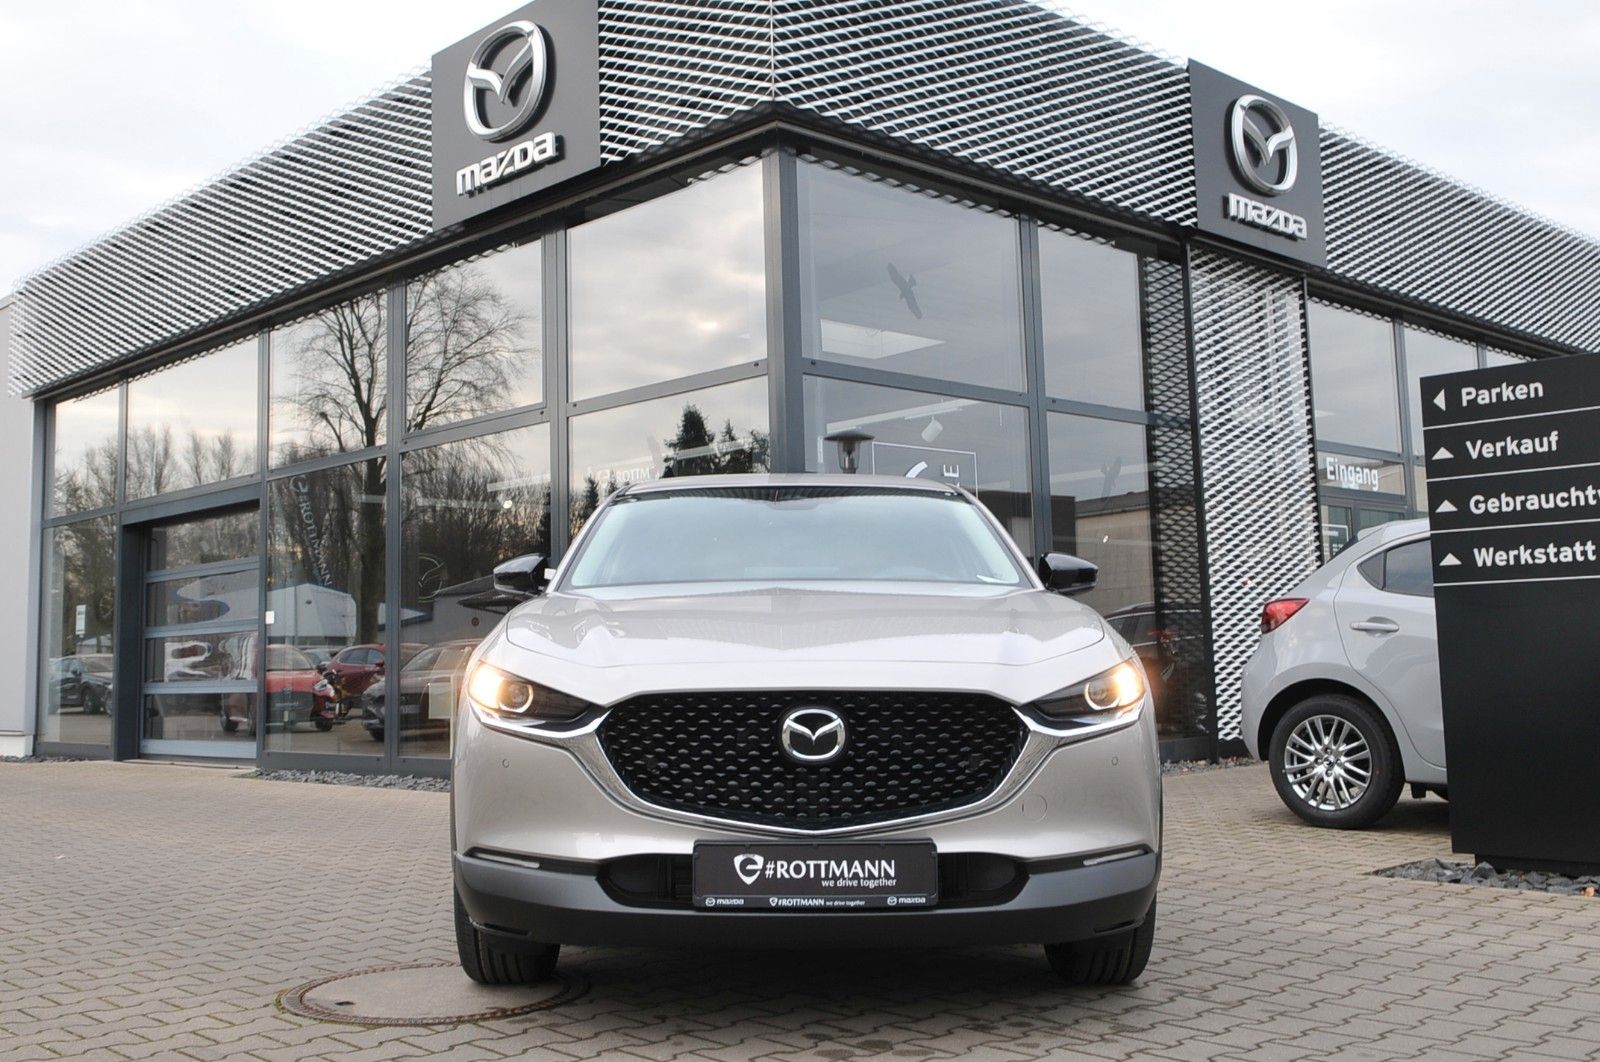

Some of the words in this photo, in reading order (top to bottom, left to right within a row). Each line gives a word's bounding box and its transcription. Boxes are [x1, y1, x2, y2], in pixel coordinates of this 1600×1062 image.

[1461, 381, 1544, 407] Parken
[1466, 431, 1559, 460] Verkauf
[1326, 456, 1379, 492] Eingang
[1473, 540, 1597, 567] Werkstatt
[765, 859, 895, 879] #ROTTMANN
[837, 878, 858, 887] drive
[860, 878, 897, 889] together
